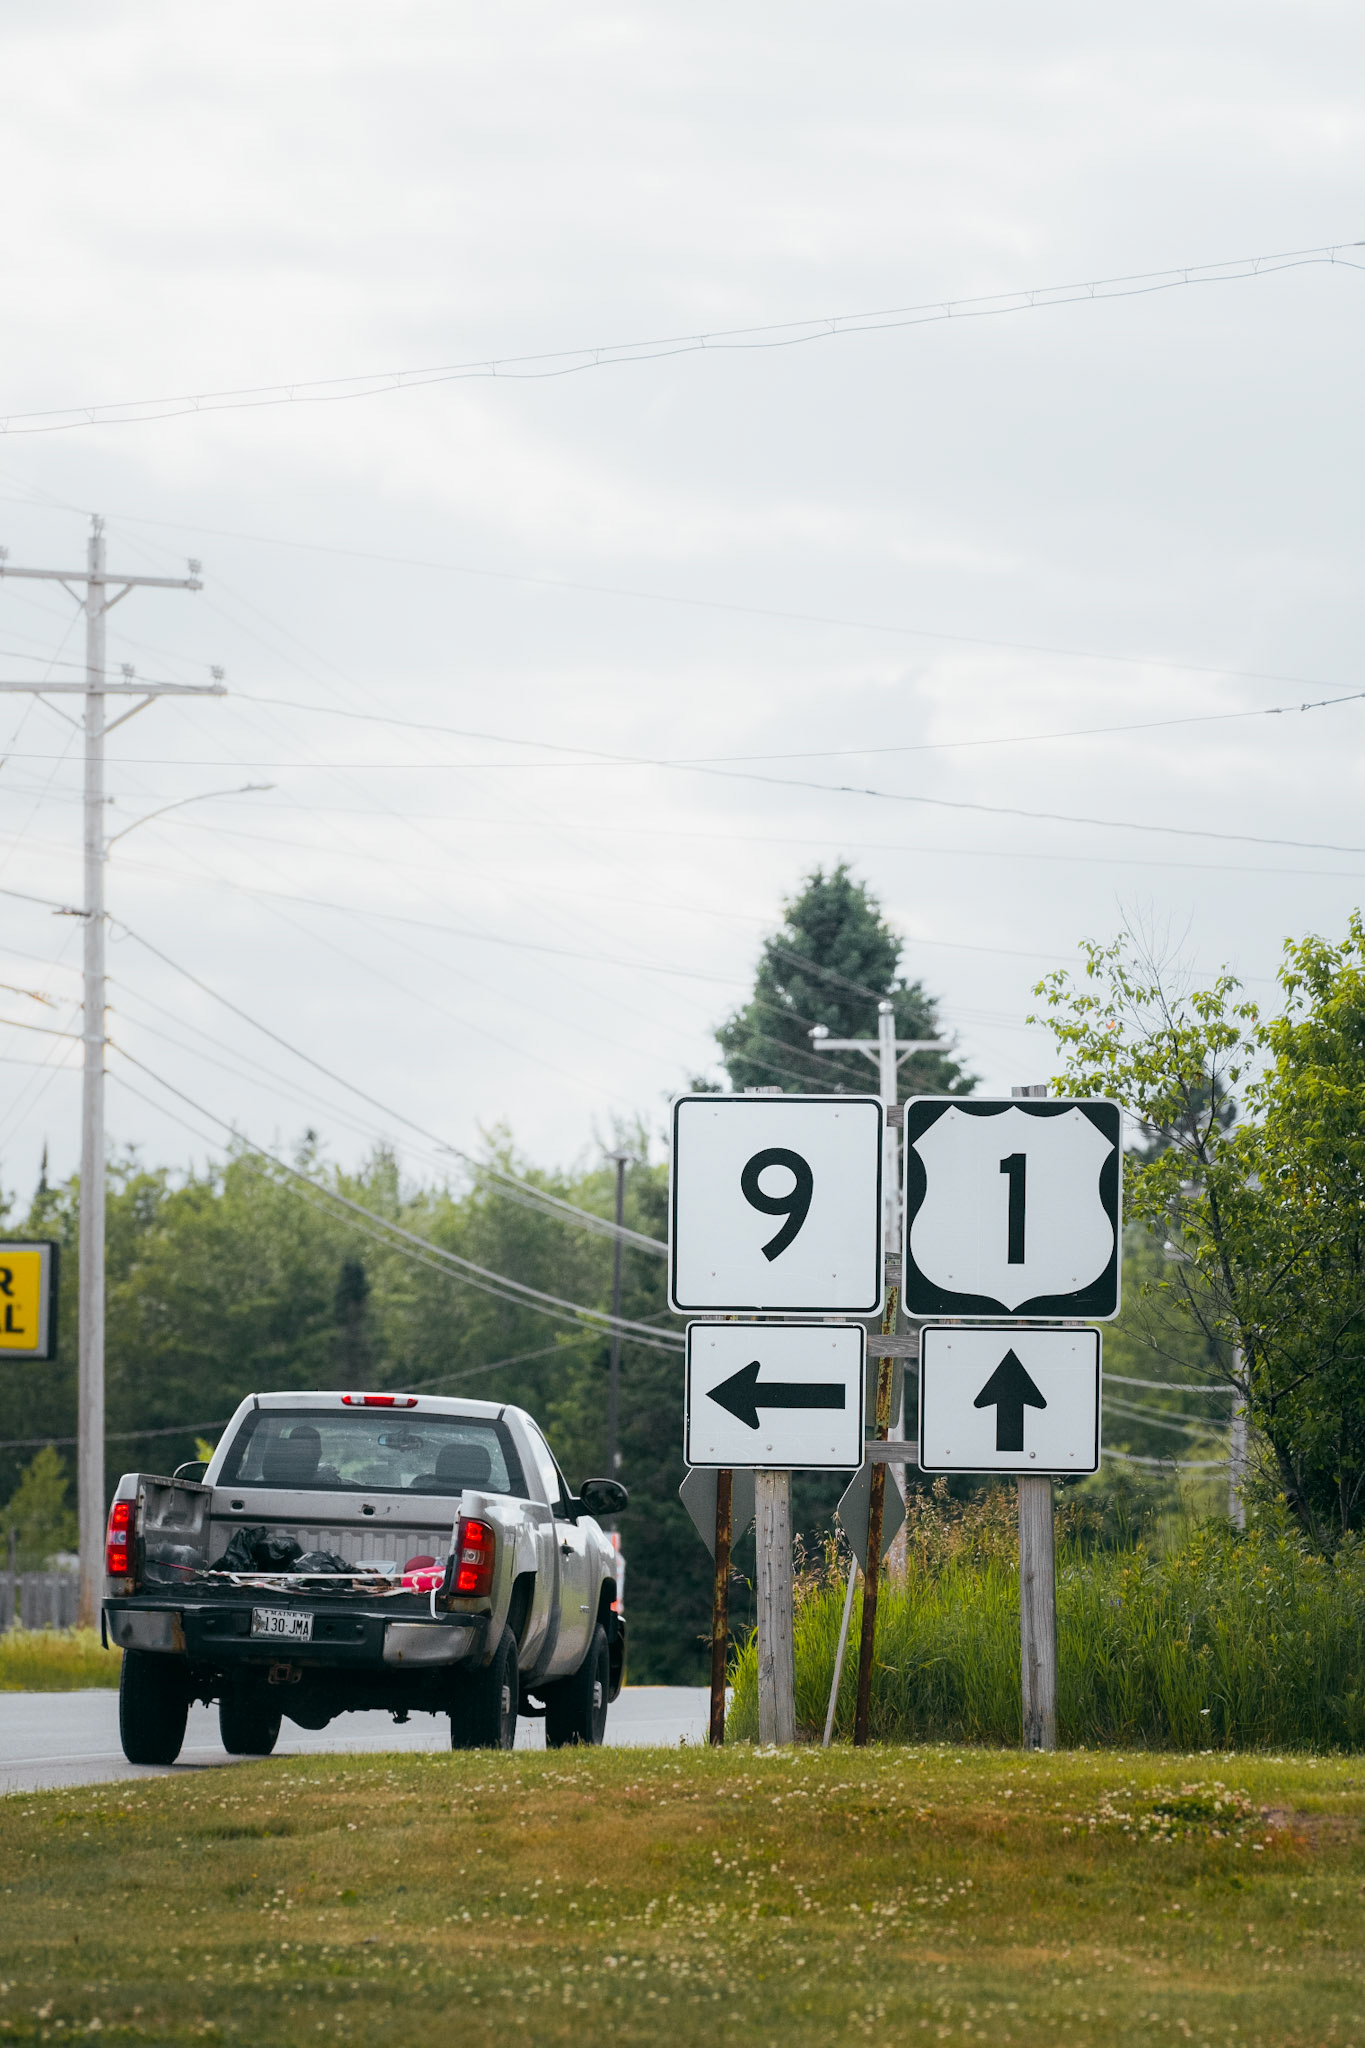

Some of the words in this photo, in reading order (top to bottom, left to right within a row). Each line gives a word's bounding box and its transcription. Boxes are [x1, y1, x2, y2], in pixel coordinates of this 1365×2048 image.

[741, 1147, 814, 1263] 9
[999, 1153, 1026, 1265] 1
[0, 1304, 25, 1333] L
